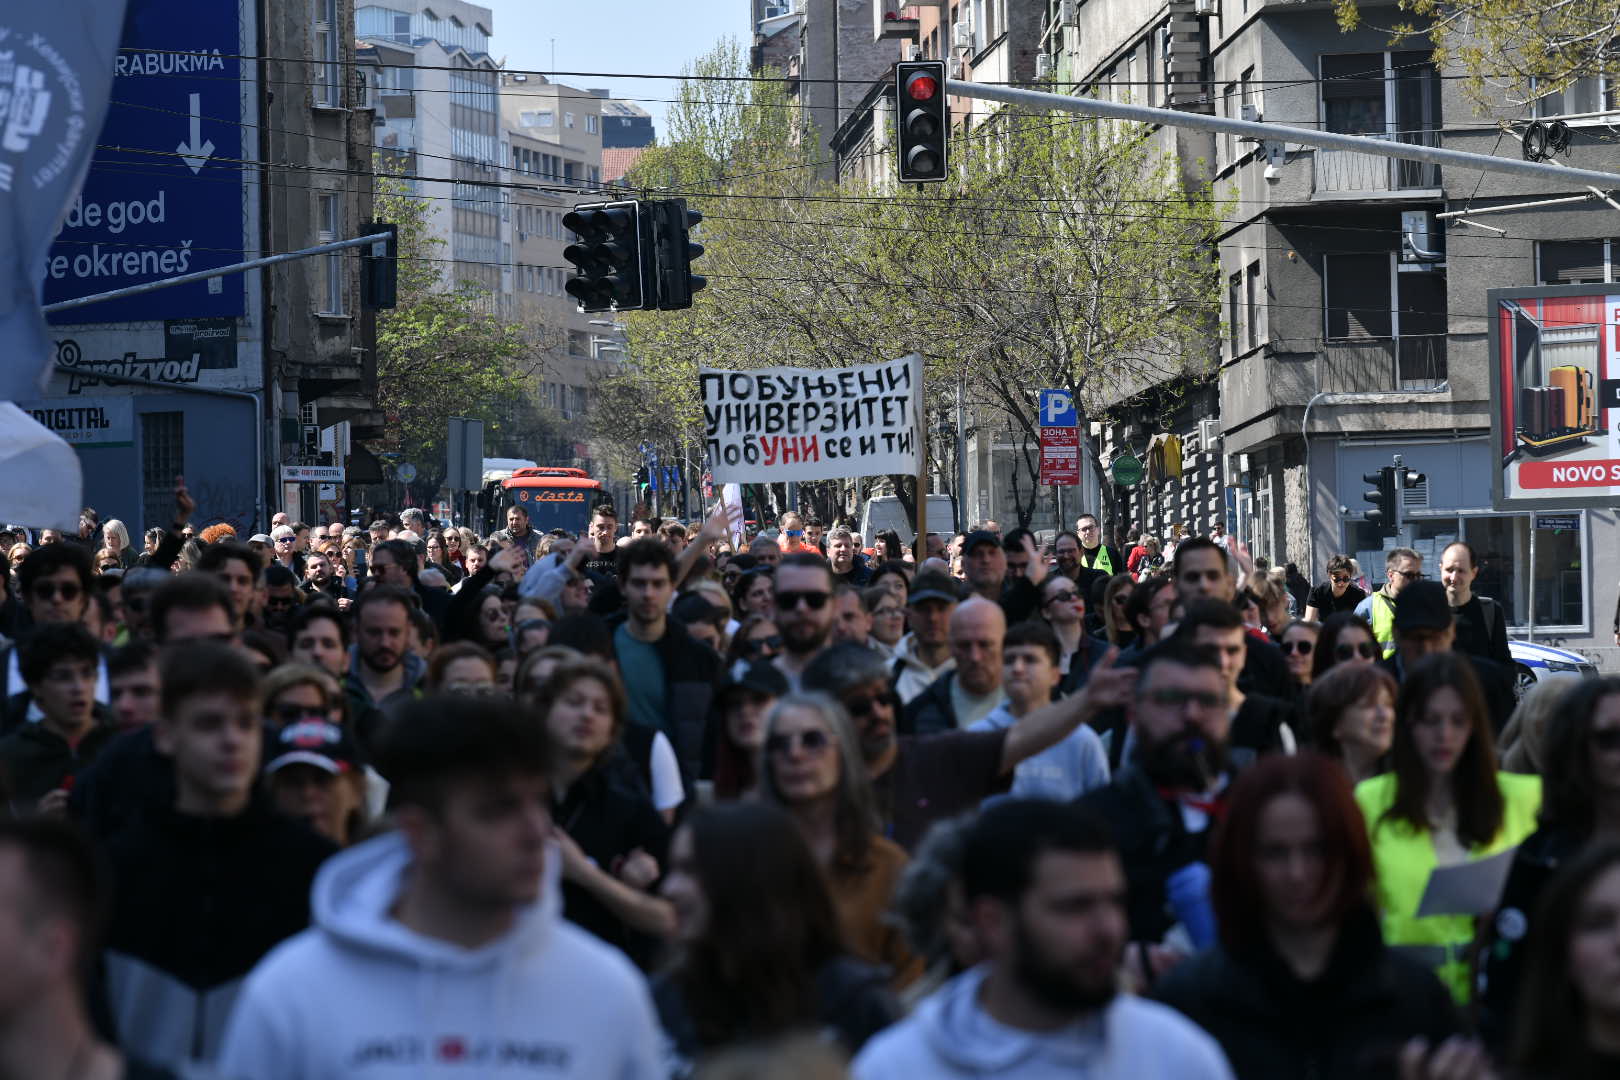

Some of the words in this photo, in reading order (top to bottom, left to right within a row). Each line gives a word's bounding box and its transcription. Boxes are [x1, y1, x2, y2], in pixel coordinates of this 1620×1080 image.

[107, 190, 166, 234] god
[74, 239, 193, 278] okreneš
[68, 351, 201, 394] proizvod
[700, 362, 911, 401] ПОБУЊЕНИ
[25, 406, 111, 431] DIGITAL
[703, 395, 910, 436] УНИВЕРЗИТЕТ
[1047, 393, 1069, 423] P
[824, 435, 852, 459] се
[858, 433, 876, 456] и
[881, 426, 915, 457] ти!
[1042, 428, 1068, 437] ЗОНА
[1552, 465, 1607, 483] NOVO
[535, 490, 585, 502] Lasta
